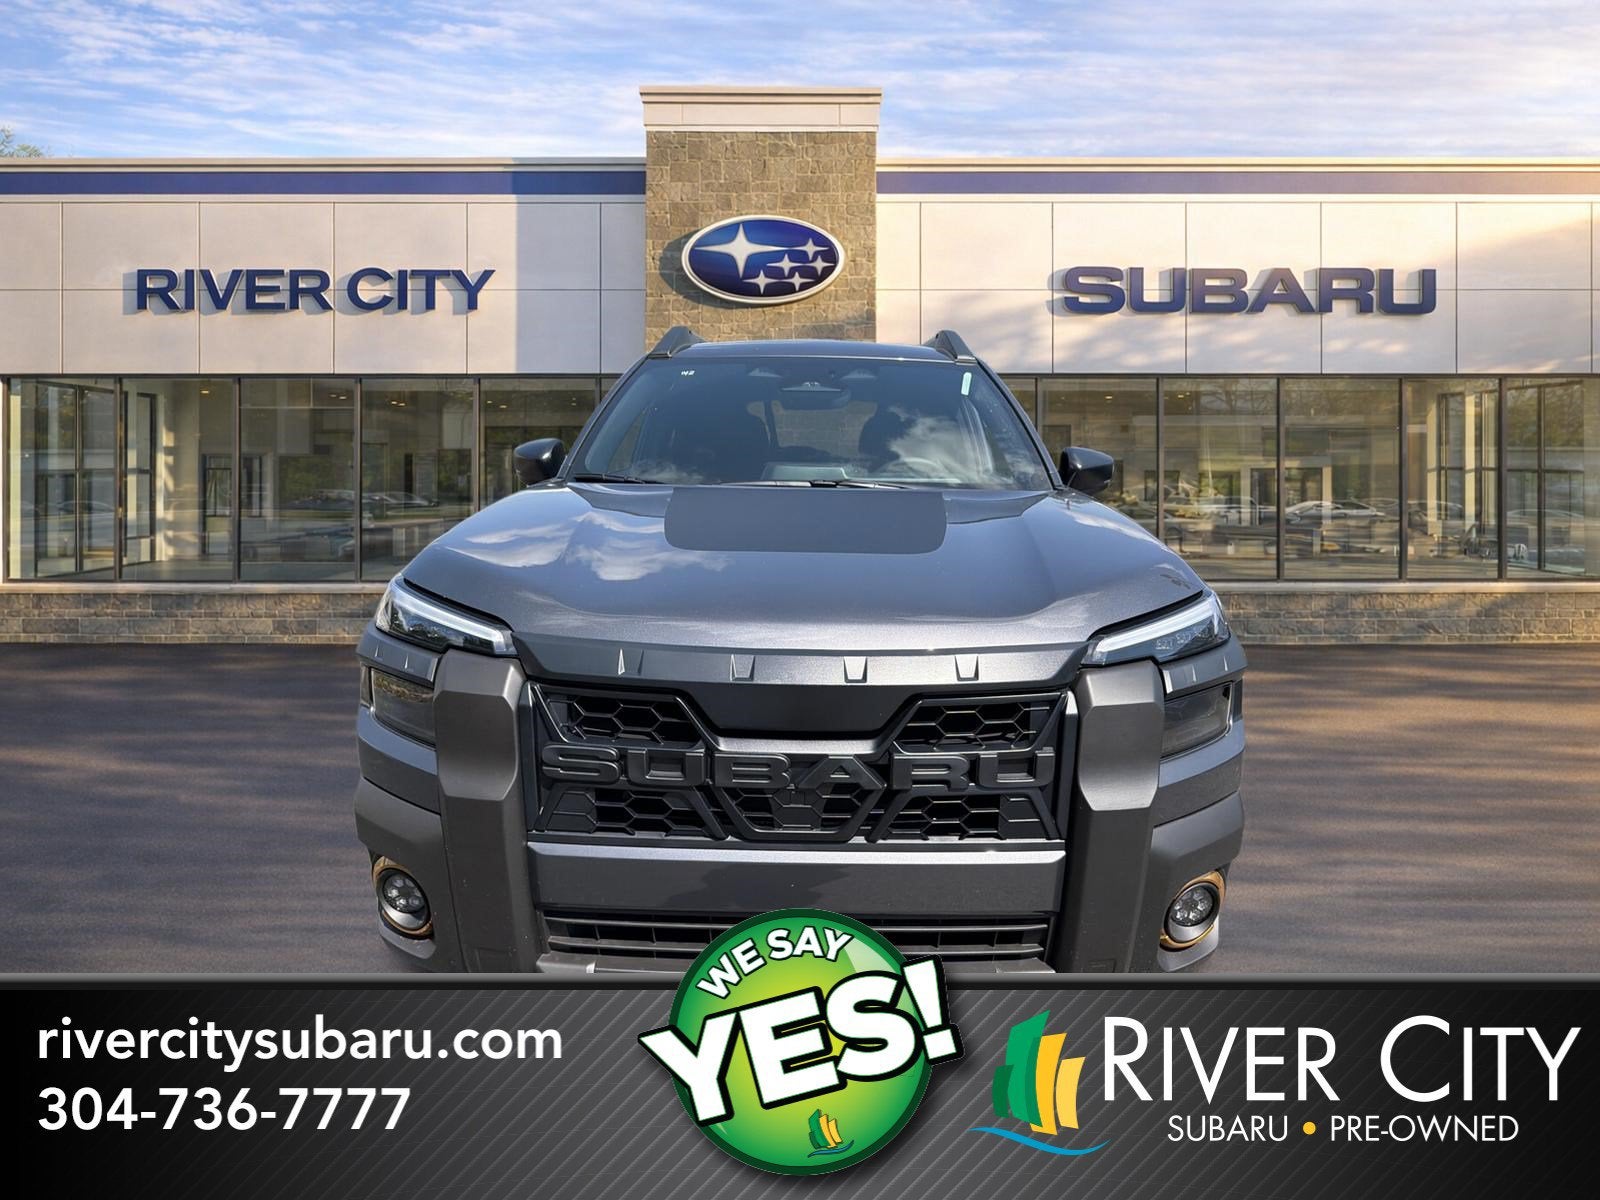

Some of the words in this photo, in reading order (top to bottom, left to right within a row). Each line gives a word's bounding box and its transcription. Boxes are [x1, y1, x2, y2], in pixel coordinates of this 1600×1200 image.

[136, 268, 334, 311] RIVER
[346, 267, 496, 311] CITY
[1063, 266, 1437, 314] SUBARU
[541, 744, 1055, 789] SUBARU
